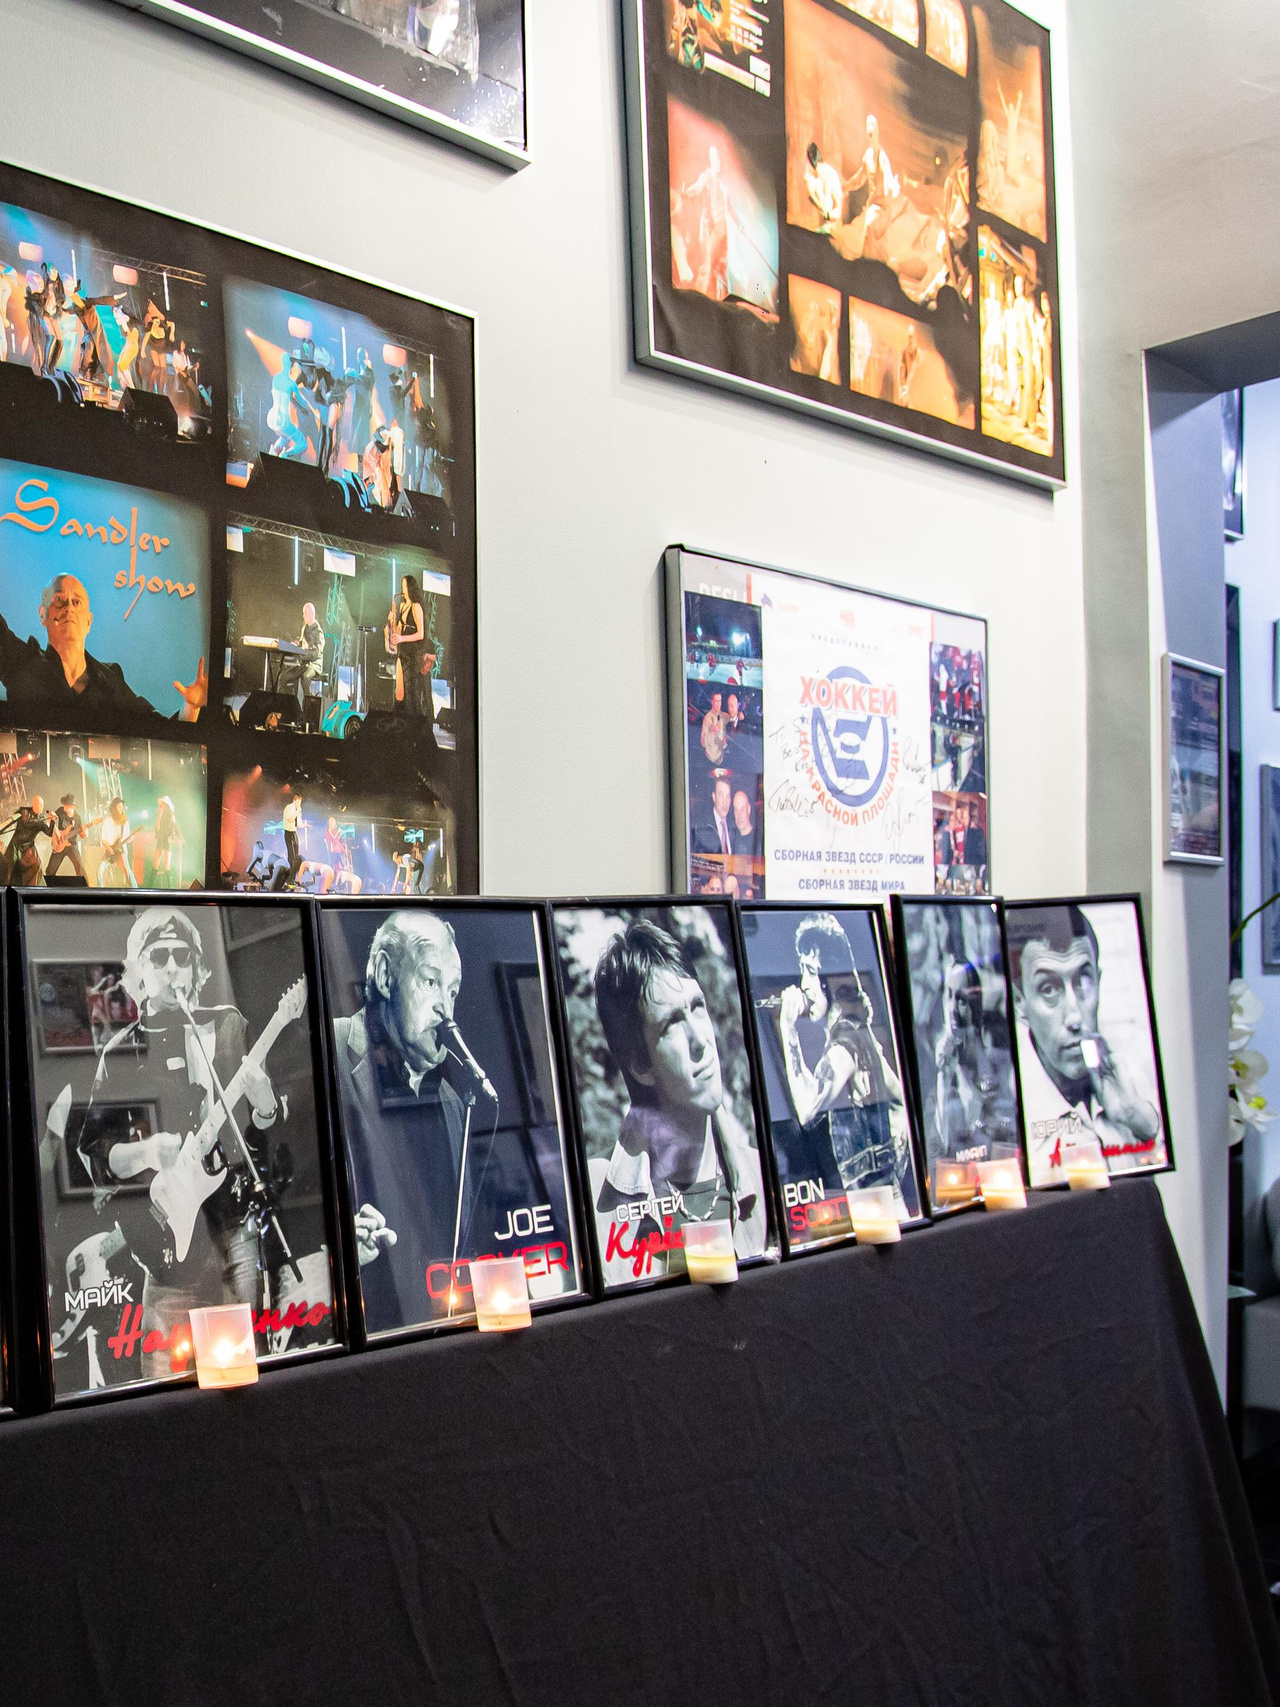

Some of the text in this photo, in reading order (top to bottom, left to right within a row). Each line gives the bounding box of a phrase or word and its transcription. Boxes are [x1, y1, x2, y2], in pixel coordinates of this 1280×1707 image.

[114, 546, 196, 620] show
[799, 674, 898, 717] ХОККЕЙ
[806, 765, 859, 827] КРАСНОЙ
[862, 740, 901, 825] ПЛОЩАДИ
[774, 849, 925, 865] СБОРНАЯ ЗВЕЗД СССР РОССИИ
[798, 878, 906, 892] СБОРНАЯ ЗВЕЗД МИРА
[616, 1190, 684, 1223] СЕРГЕЙ
[783, 1177, 825, 1208] BON
[493, 1204, 554, 1241] JOE
[790, 1196, 849, 1232] SCOT
[425, 1241, 569, 1299] COER
[64, 1280, 134, 1312] МАЙК
